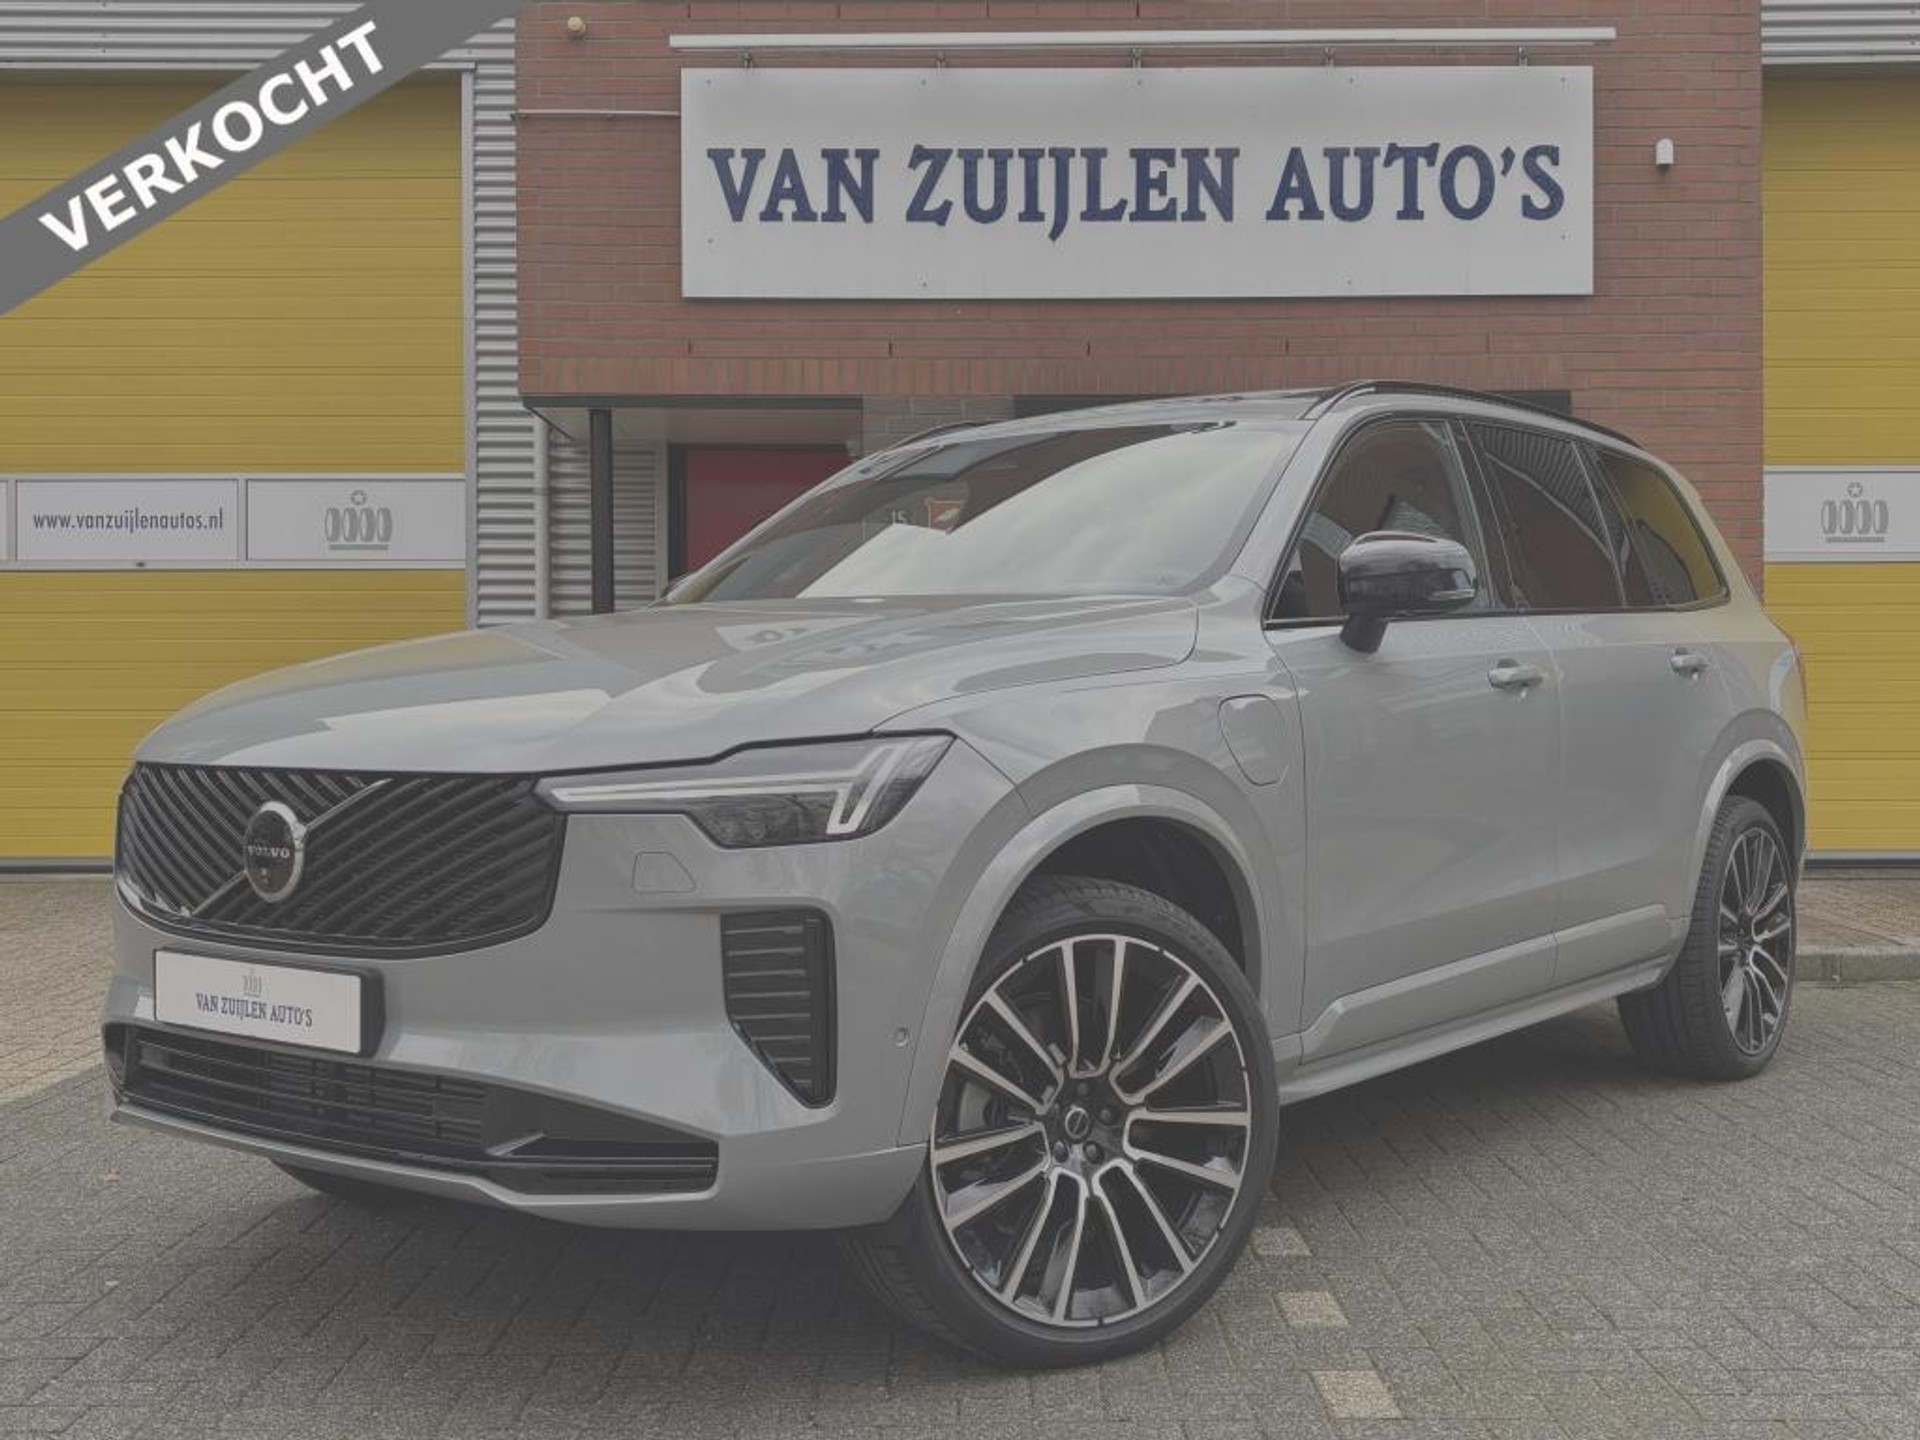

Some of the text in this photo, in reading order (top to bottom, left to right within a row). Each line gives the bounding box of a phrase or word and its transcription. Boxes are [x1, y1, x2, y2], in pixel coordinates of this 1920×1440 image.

[707, 143, 1564, 242] VAN ZUIJLEN AUTO'S
[33, 506, 224, 535] www.vanzuijlenautos.nl
[246, 845, 291, 859] VOLVO
[195, 992, 314, 1028] VAN ZUIJLEN AUTO'S
